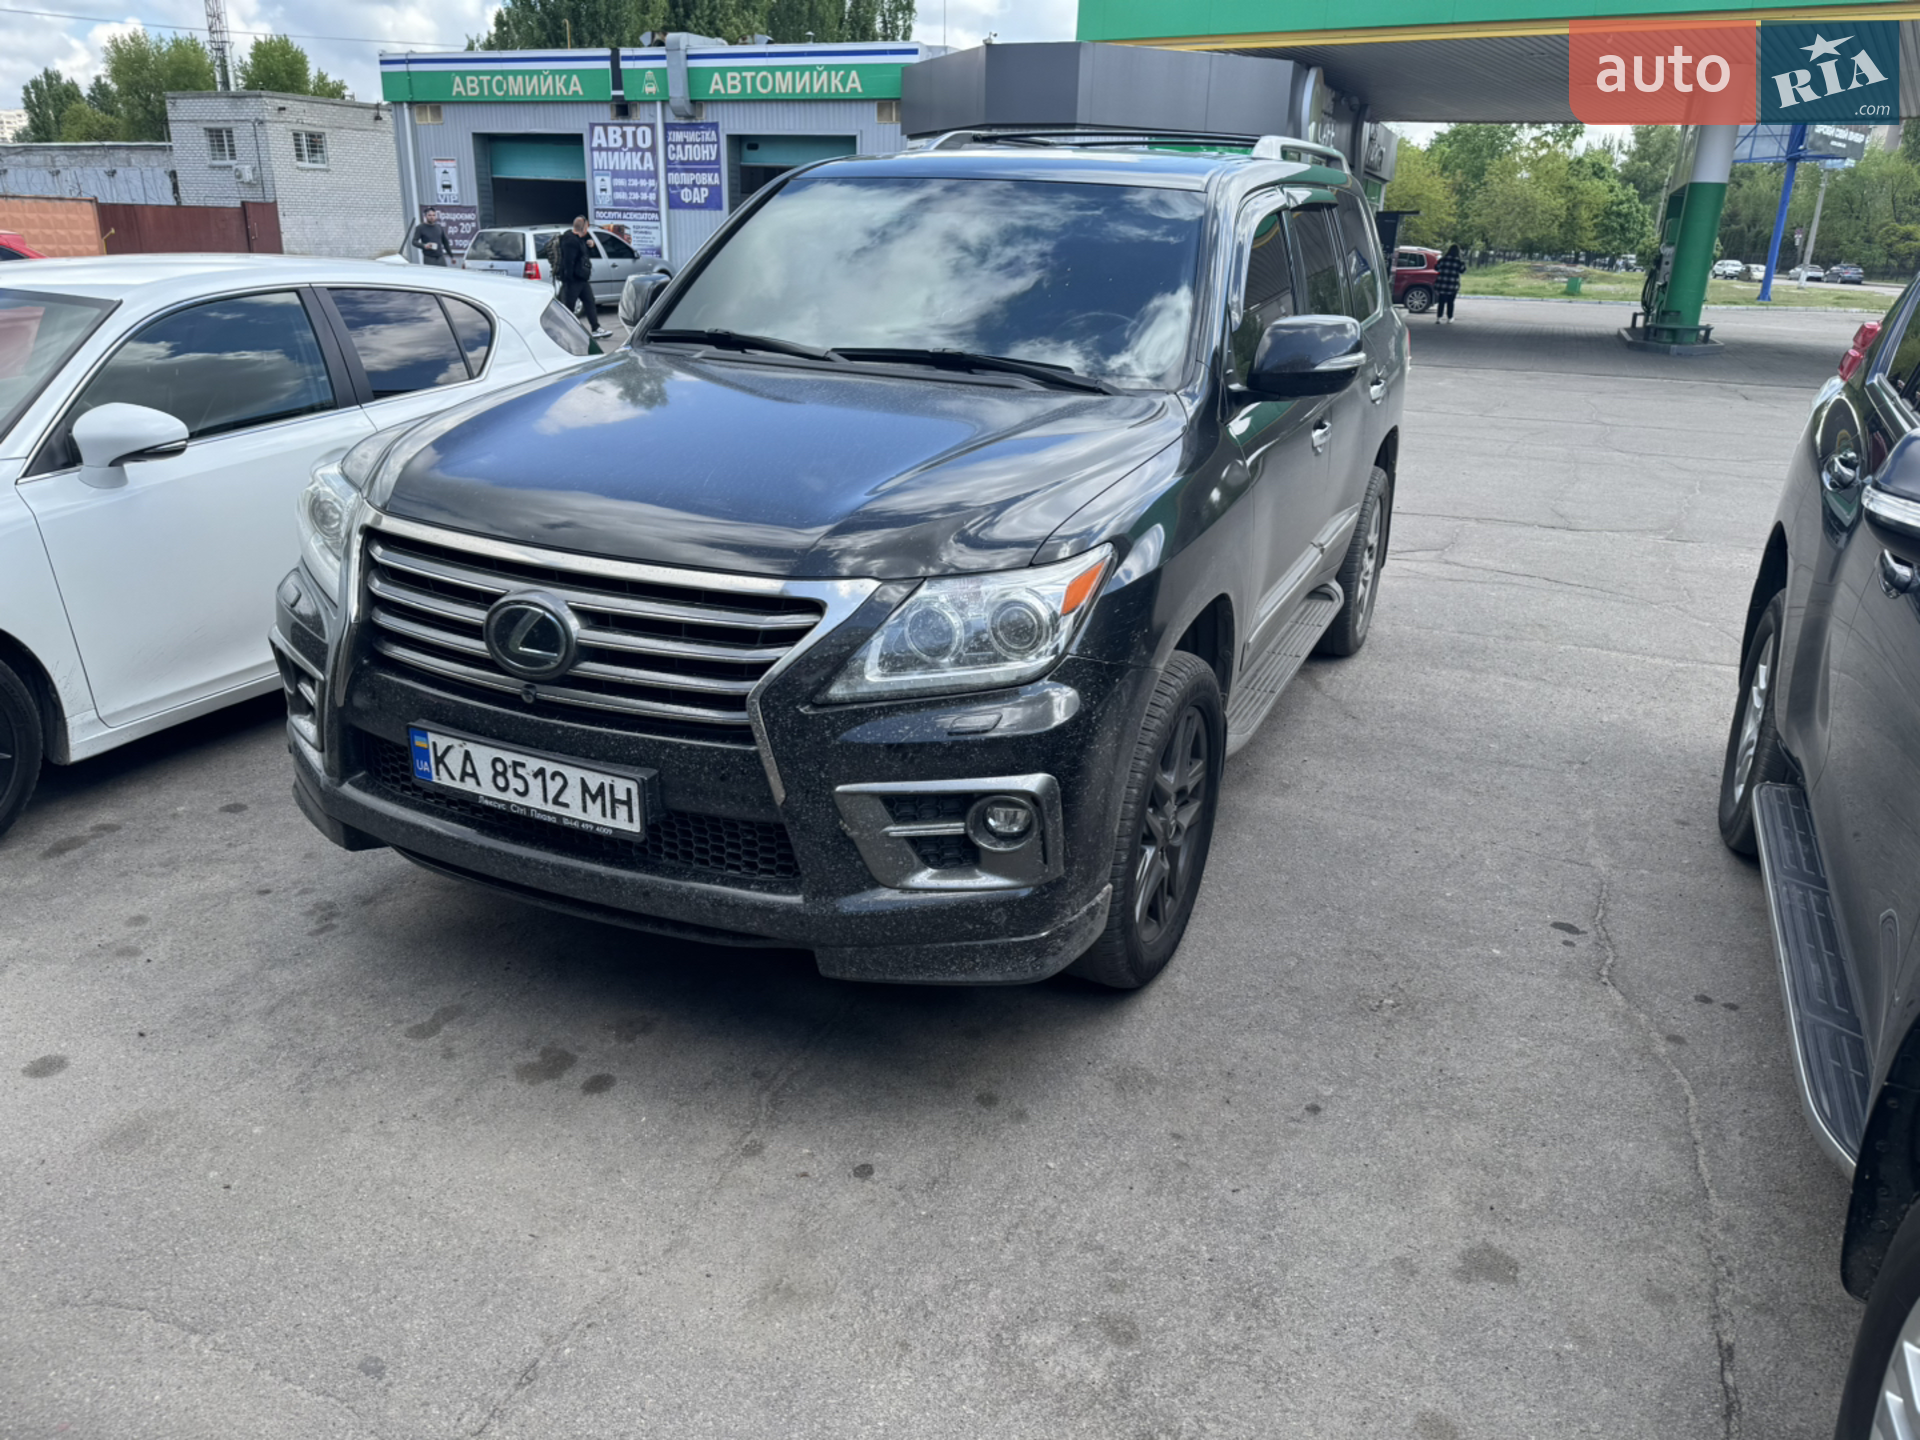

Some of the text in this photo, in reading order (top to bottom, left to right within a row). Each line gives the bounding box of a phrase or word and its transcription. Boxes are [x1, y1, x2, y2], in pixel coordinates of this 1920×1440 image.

[452, 70, 584, 97] АВТОМИЙКА
[708, 65, 864, 95] АВТОМИЙКА
[591, 126, 652, 149] АВТО
[667, 130, 718, 142] ХІМЧИСТКА
[592, 147, 655, 171] МИЙКА
[667, 143, 718, 162] САЛОНУ
[667, 172, 720, 185] ПОЛІРОВКА
[438, 194, 458, 203] VIP
[680, 186, 709, 204] ФАР
[448, 226, 458, 234] до
[415, 758, 431, 773] UA
[490, 756, 570, 809] 8512
[478, 795, 507, 811] Лексус
[530, 809, 558, 824] Плаза
